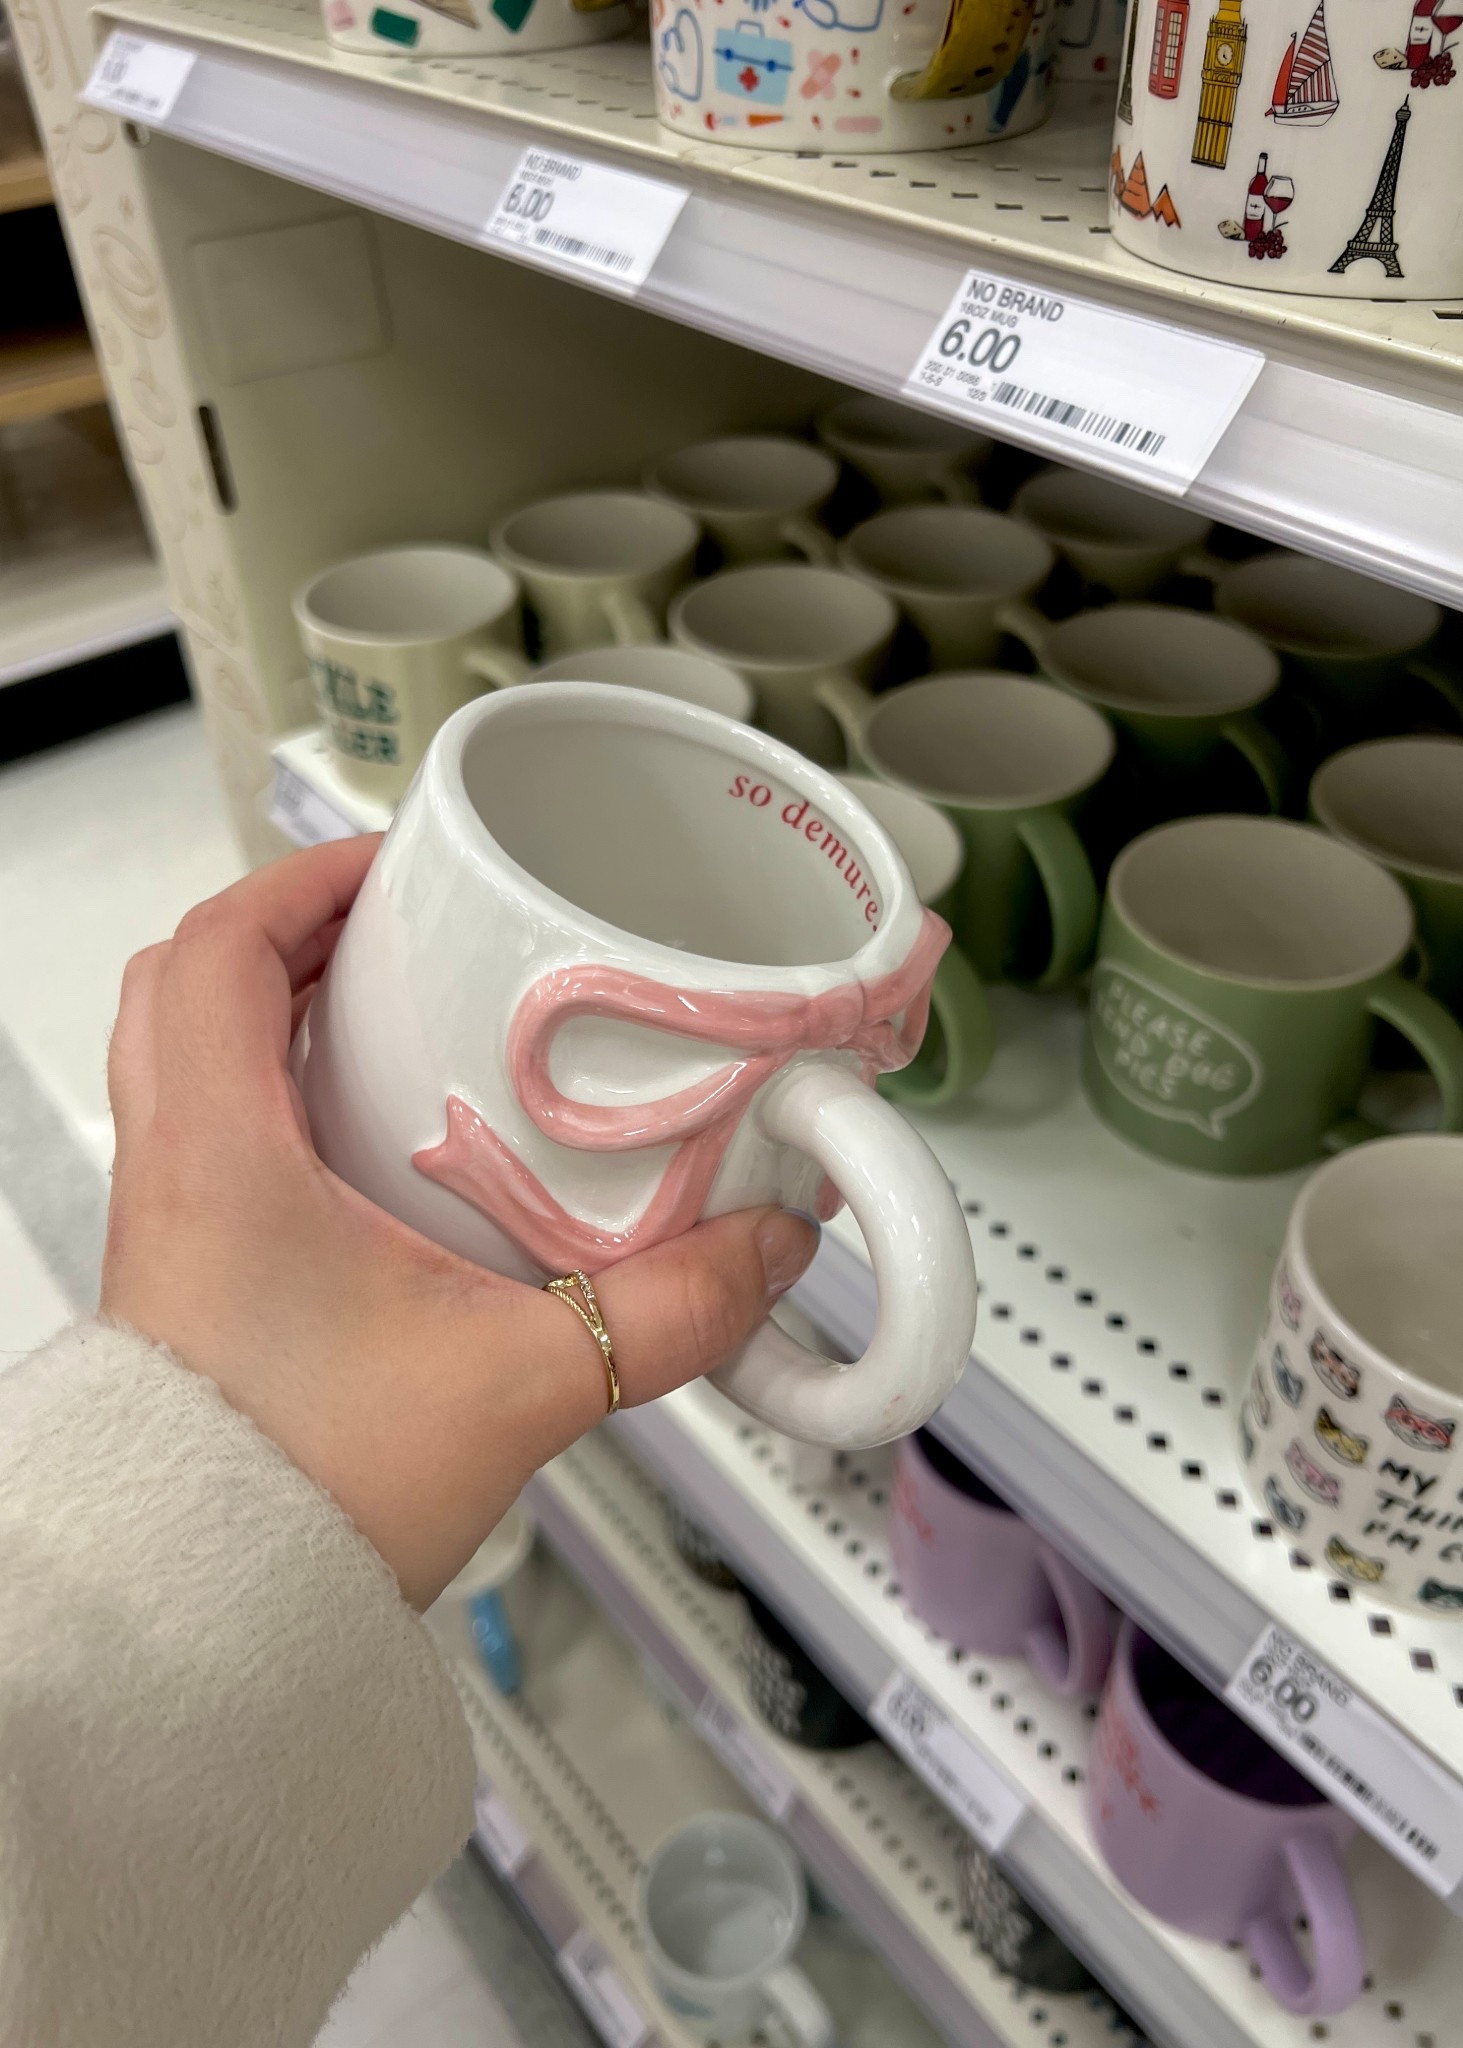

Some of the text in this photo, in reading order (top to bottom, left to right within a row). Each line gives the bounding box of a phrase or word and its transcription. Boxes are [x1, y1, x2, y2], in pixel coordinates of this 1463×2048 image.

[506, 184, 554, 221] 6.00
[966, 278, 1065, 322] NO BRAND
[991, 310, 1018, 328] MUG
[939, 319, 1022, 374] 6.00
[728, 775, 773, 807] so
[1164, 1051, 1234, 1092] DOG
[1378, 1456, 1438, 1497] MY
[1249, 1656, 1319, 1723] 6.00
